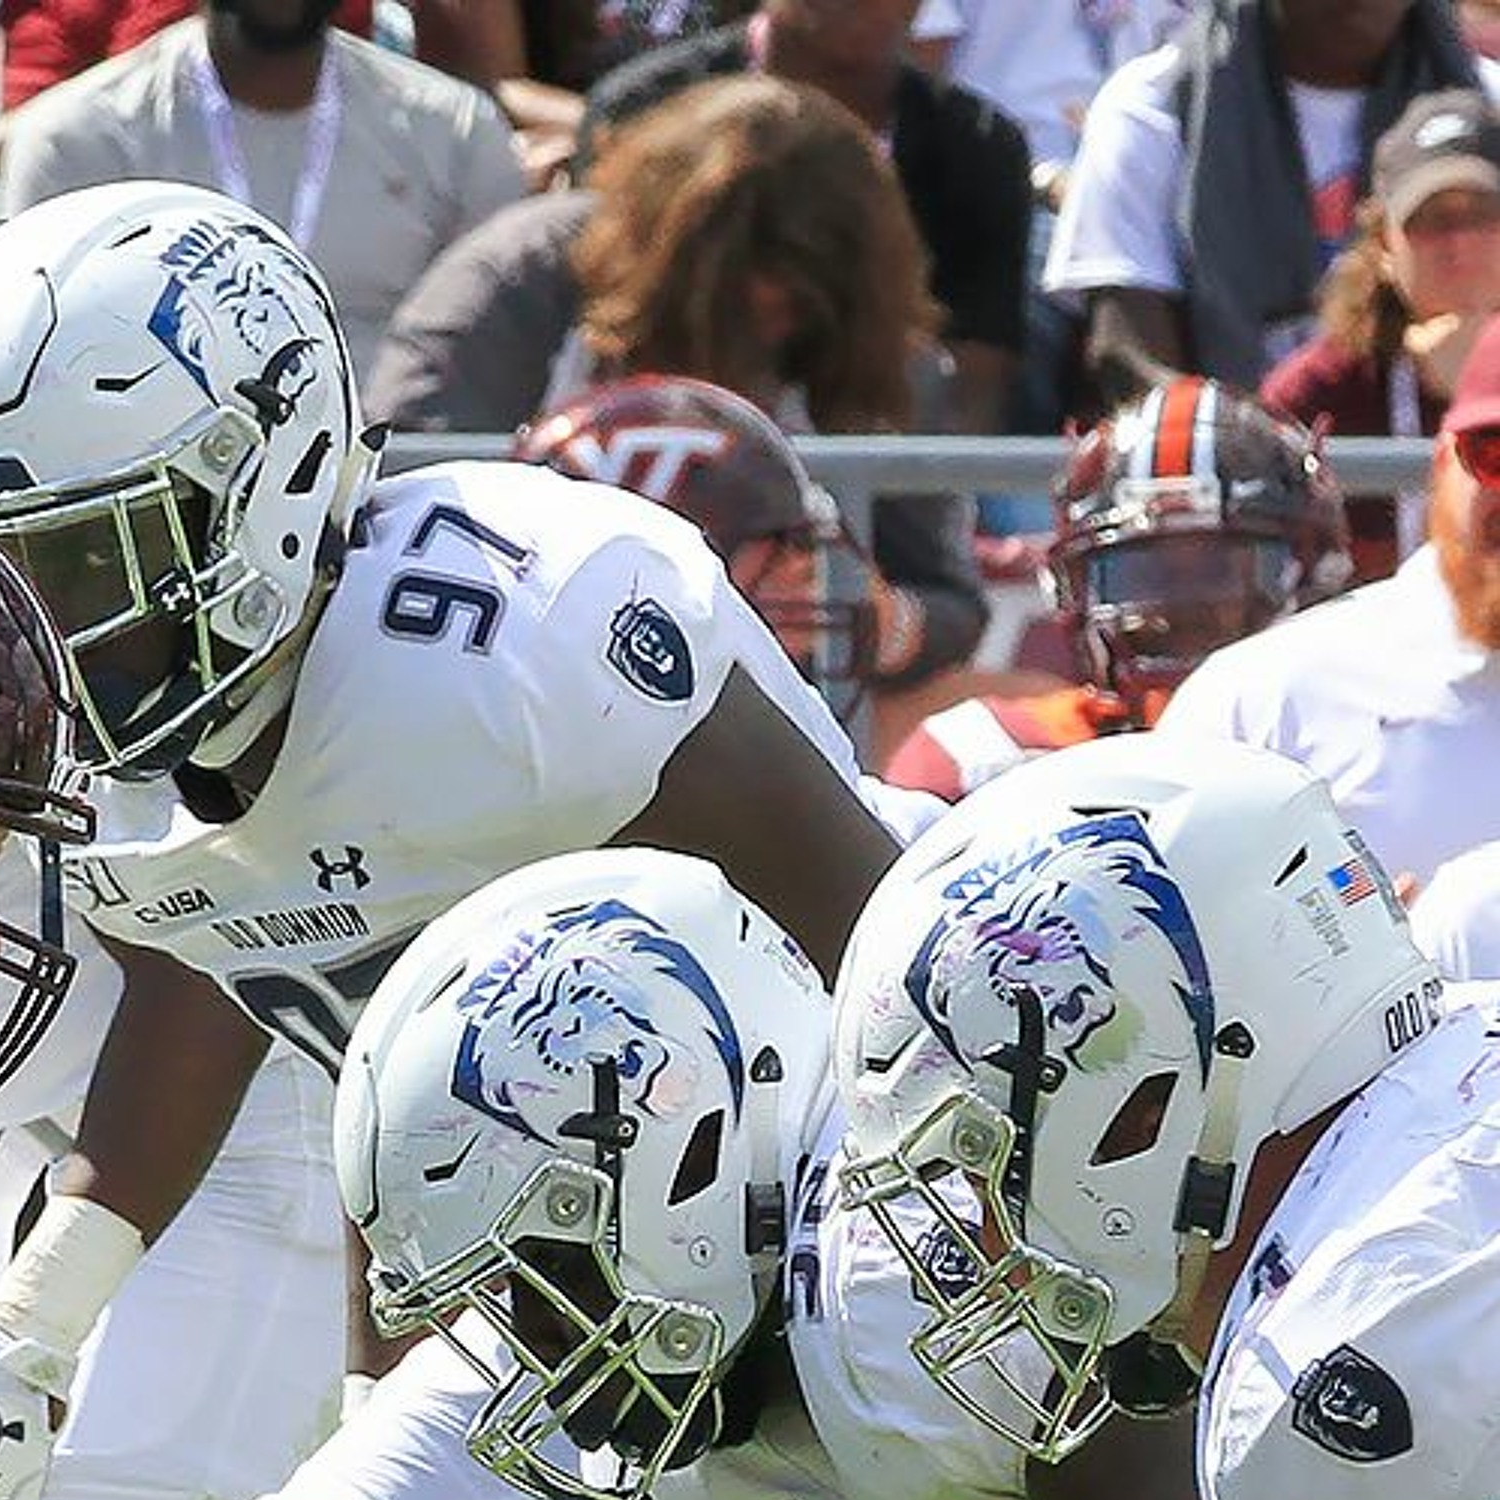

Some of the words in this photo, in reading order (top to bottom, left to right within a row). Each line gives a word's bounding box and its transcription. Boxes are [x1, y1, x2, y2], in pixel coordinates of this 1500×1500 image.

[566, 424, 738, 500] VT
[379, 502, 538, 656] 97
[254, 901, 371, 947] DOMINION
[1384, 991, 1424, 1053] OLD
